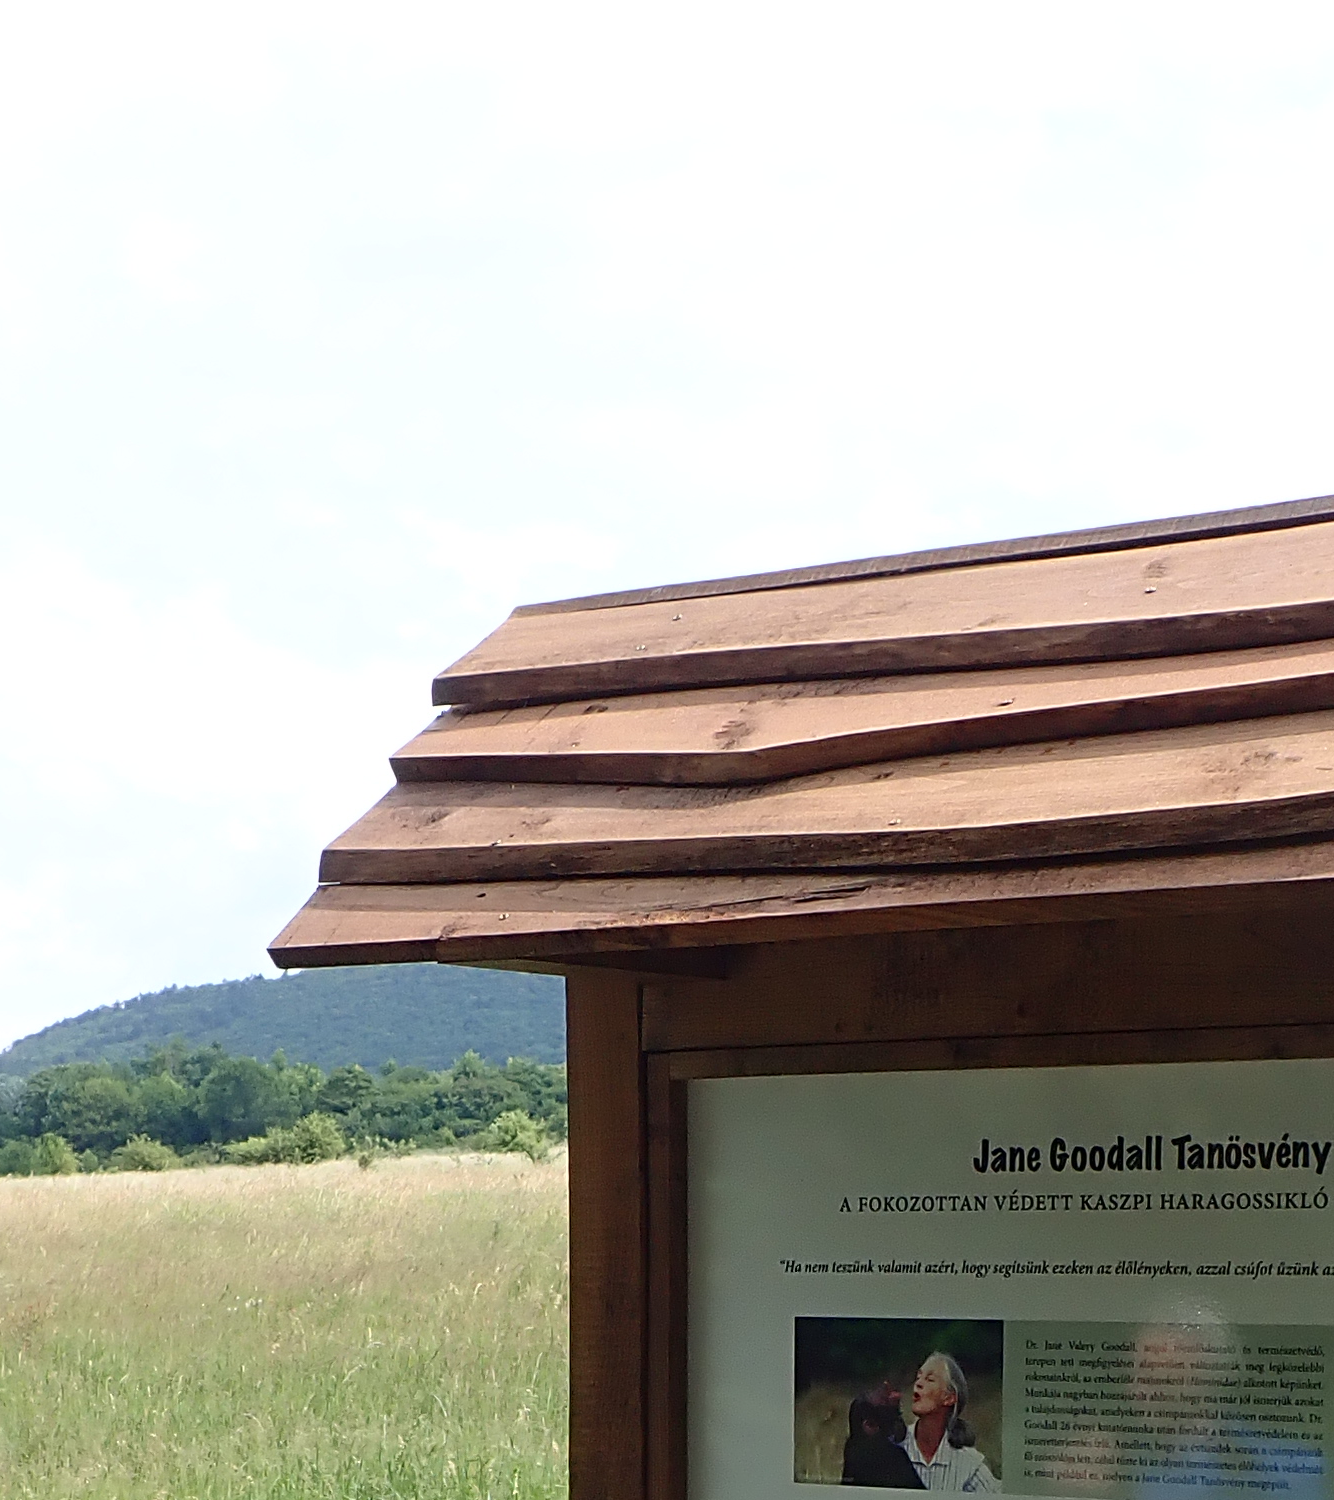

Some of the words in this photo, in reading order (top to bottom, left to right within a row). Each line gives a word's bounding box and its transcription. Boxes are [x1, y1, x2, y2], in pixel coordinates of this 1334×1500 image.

[973, 1139, 1041, 1173] Jane
[1050, 1136, 1162, 1172] Goodall
[1172, 1133, 1331, 1174] Tanösvény
[840, 1197, 852, 1212] A
[858, 1196, 987, 1212] FOKOZOTTAN
[993, 1190, 1073, 1211] VÉDETT
[1080, 1195, 1152, 1210] KASZPI
[1160, 1187, 1328, 1209] HARAGOSSIKLÓ
[805, 1263, 828, 1273] nem
[832, 1260, 874, 1273] teszünk
[878, 1260, 922, 1274] valamit
[924, 1261, 959, 1274] azért,
[962, 1260, 990, 1277] hogy
[993, 1260, 1049, 1277] segítsünk
[1052, 1261, 1093, 1274] ezeken
[1097, 1265, 1111, 1274] az
[1196, 1261, 1230, 1275] azzal
[1234, 1260, 1272, 1280] csúfot
[1277, 1262, 1318, 1276] űzünk
[1245, 1363, 1264, 1374] meg
